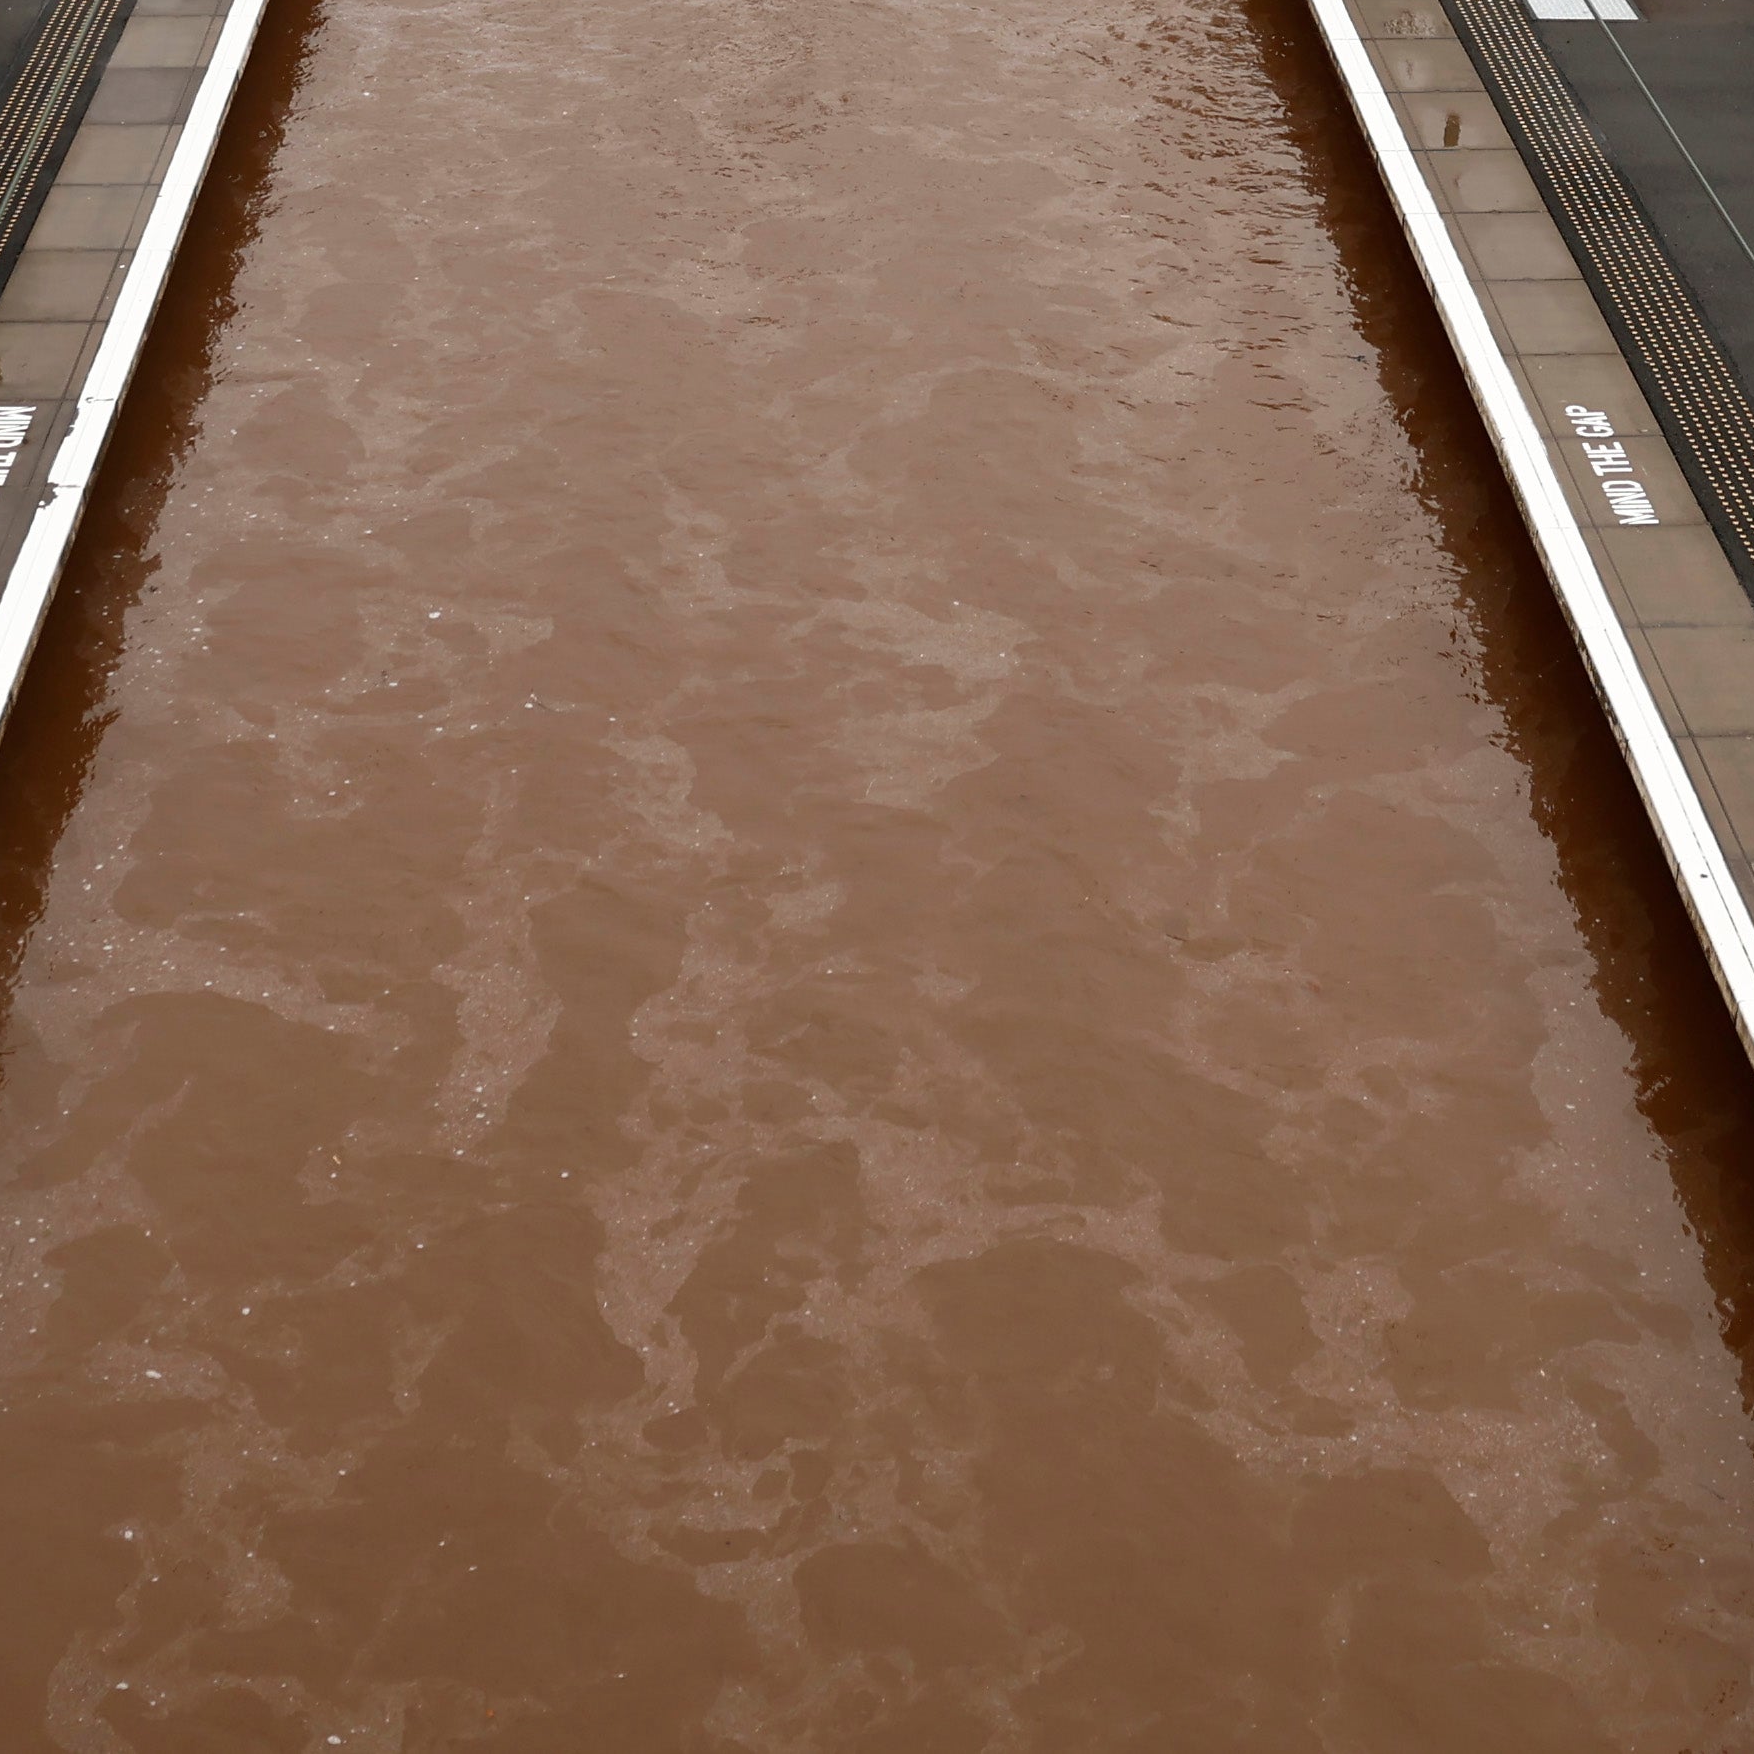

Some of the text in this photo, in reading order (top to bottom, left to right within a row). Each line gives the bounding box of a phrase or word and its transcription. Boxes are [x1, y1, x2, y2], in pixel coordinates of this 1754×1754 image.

[1564, 405, 1660, 525] MIND THE GAP
